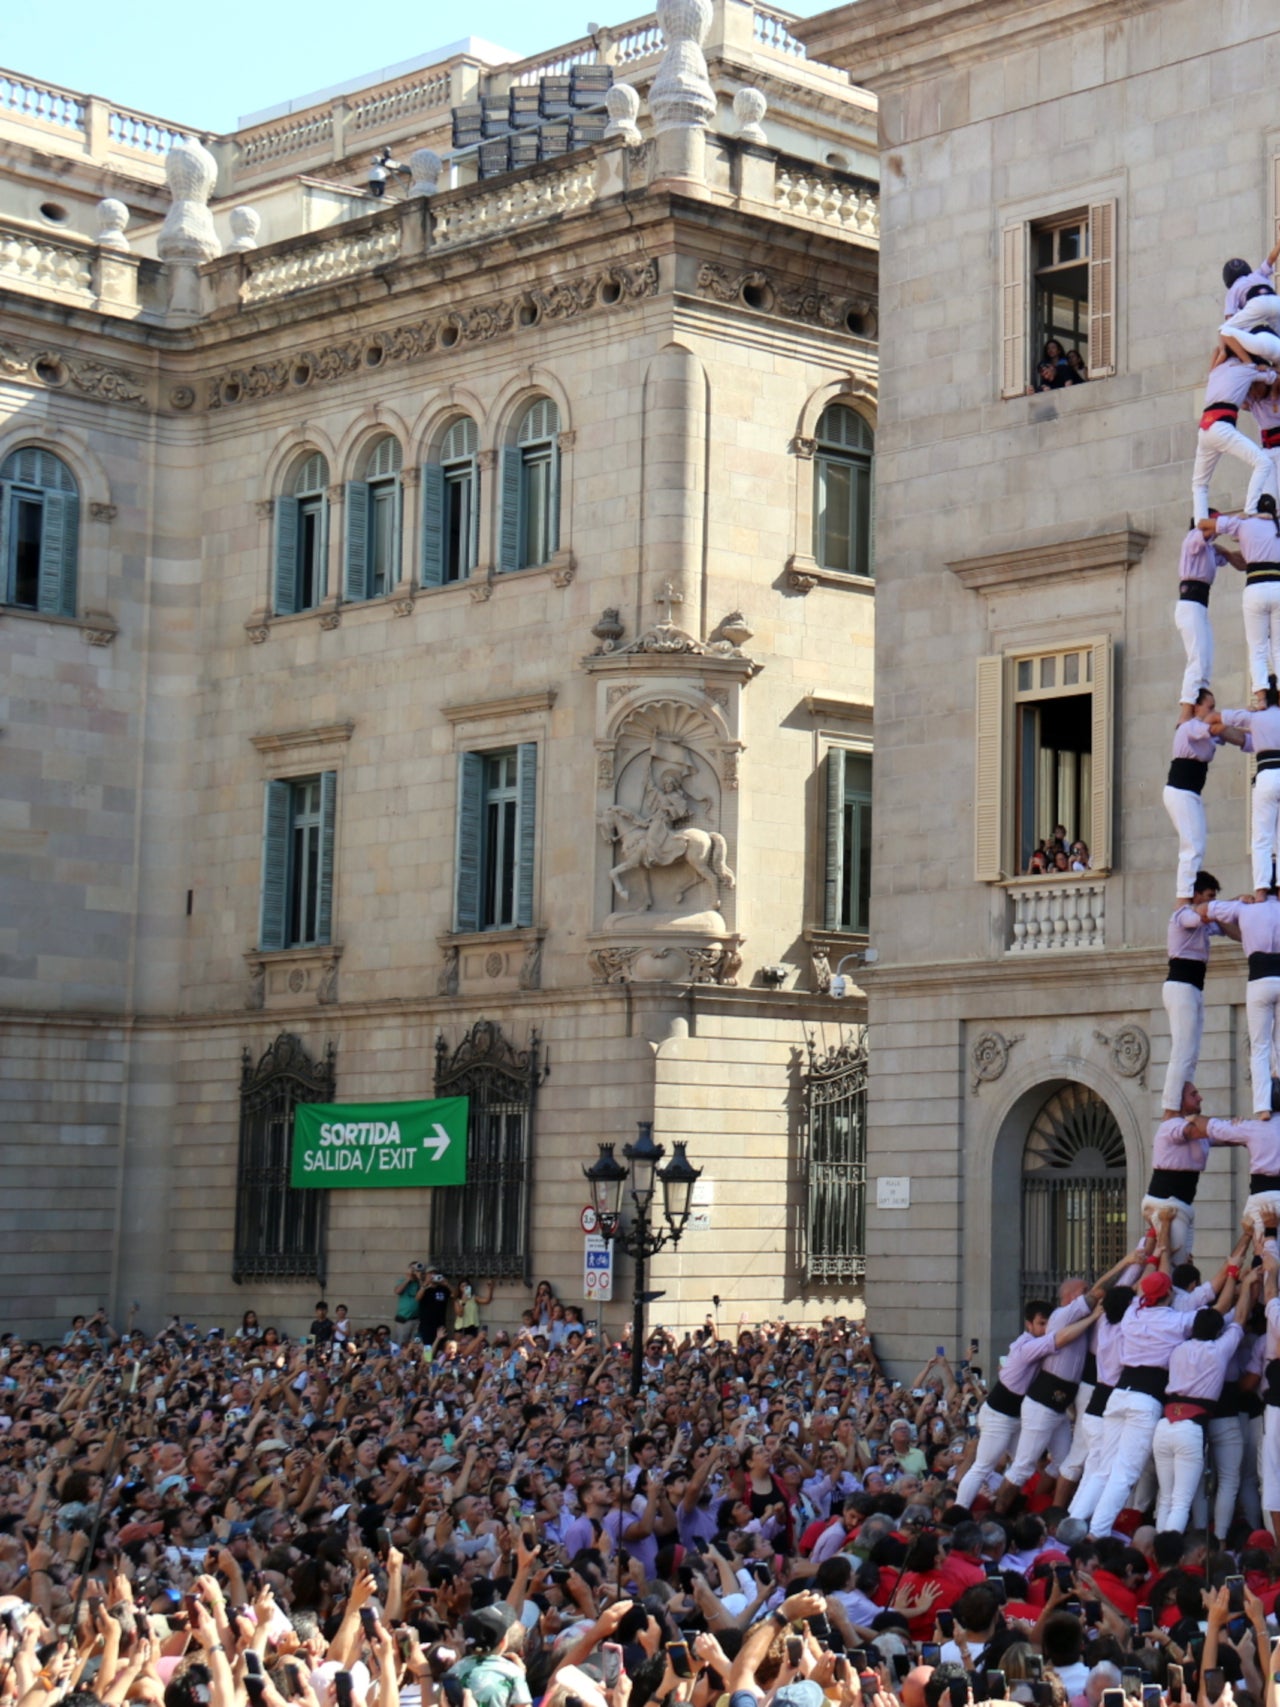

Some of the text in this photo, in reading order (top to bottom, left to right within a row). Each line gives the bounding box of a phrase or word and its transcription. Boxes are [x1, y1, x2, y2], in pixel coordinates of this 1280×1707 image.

[319, 1121, 401, 1146] SORTIDA
[303, 1149, 363, 1171] SALIDA
[379, 1147, 417, 1170] EXIT
